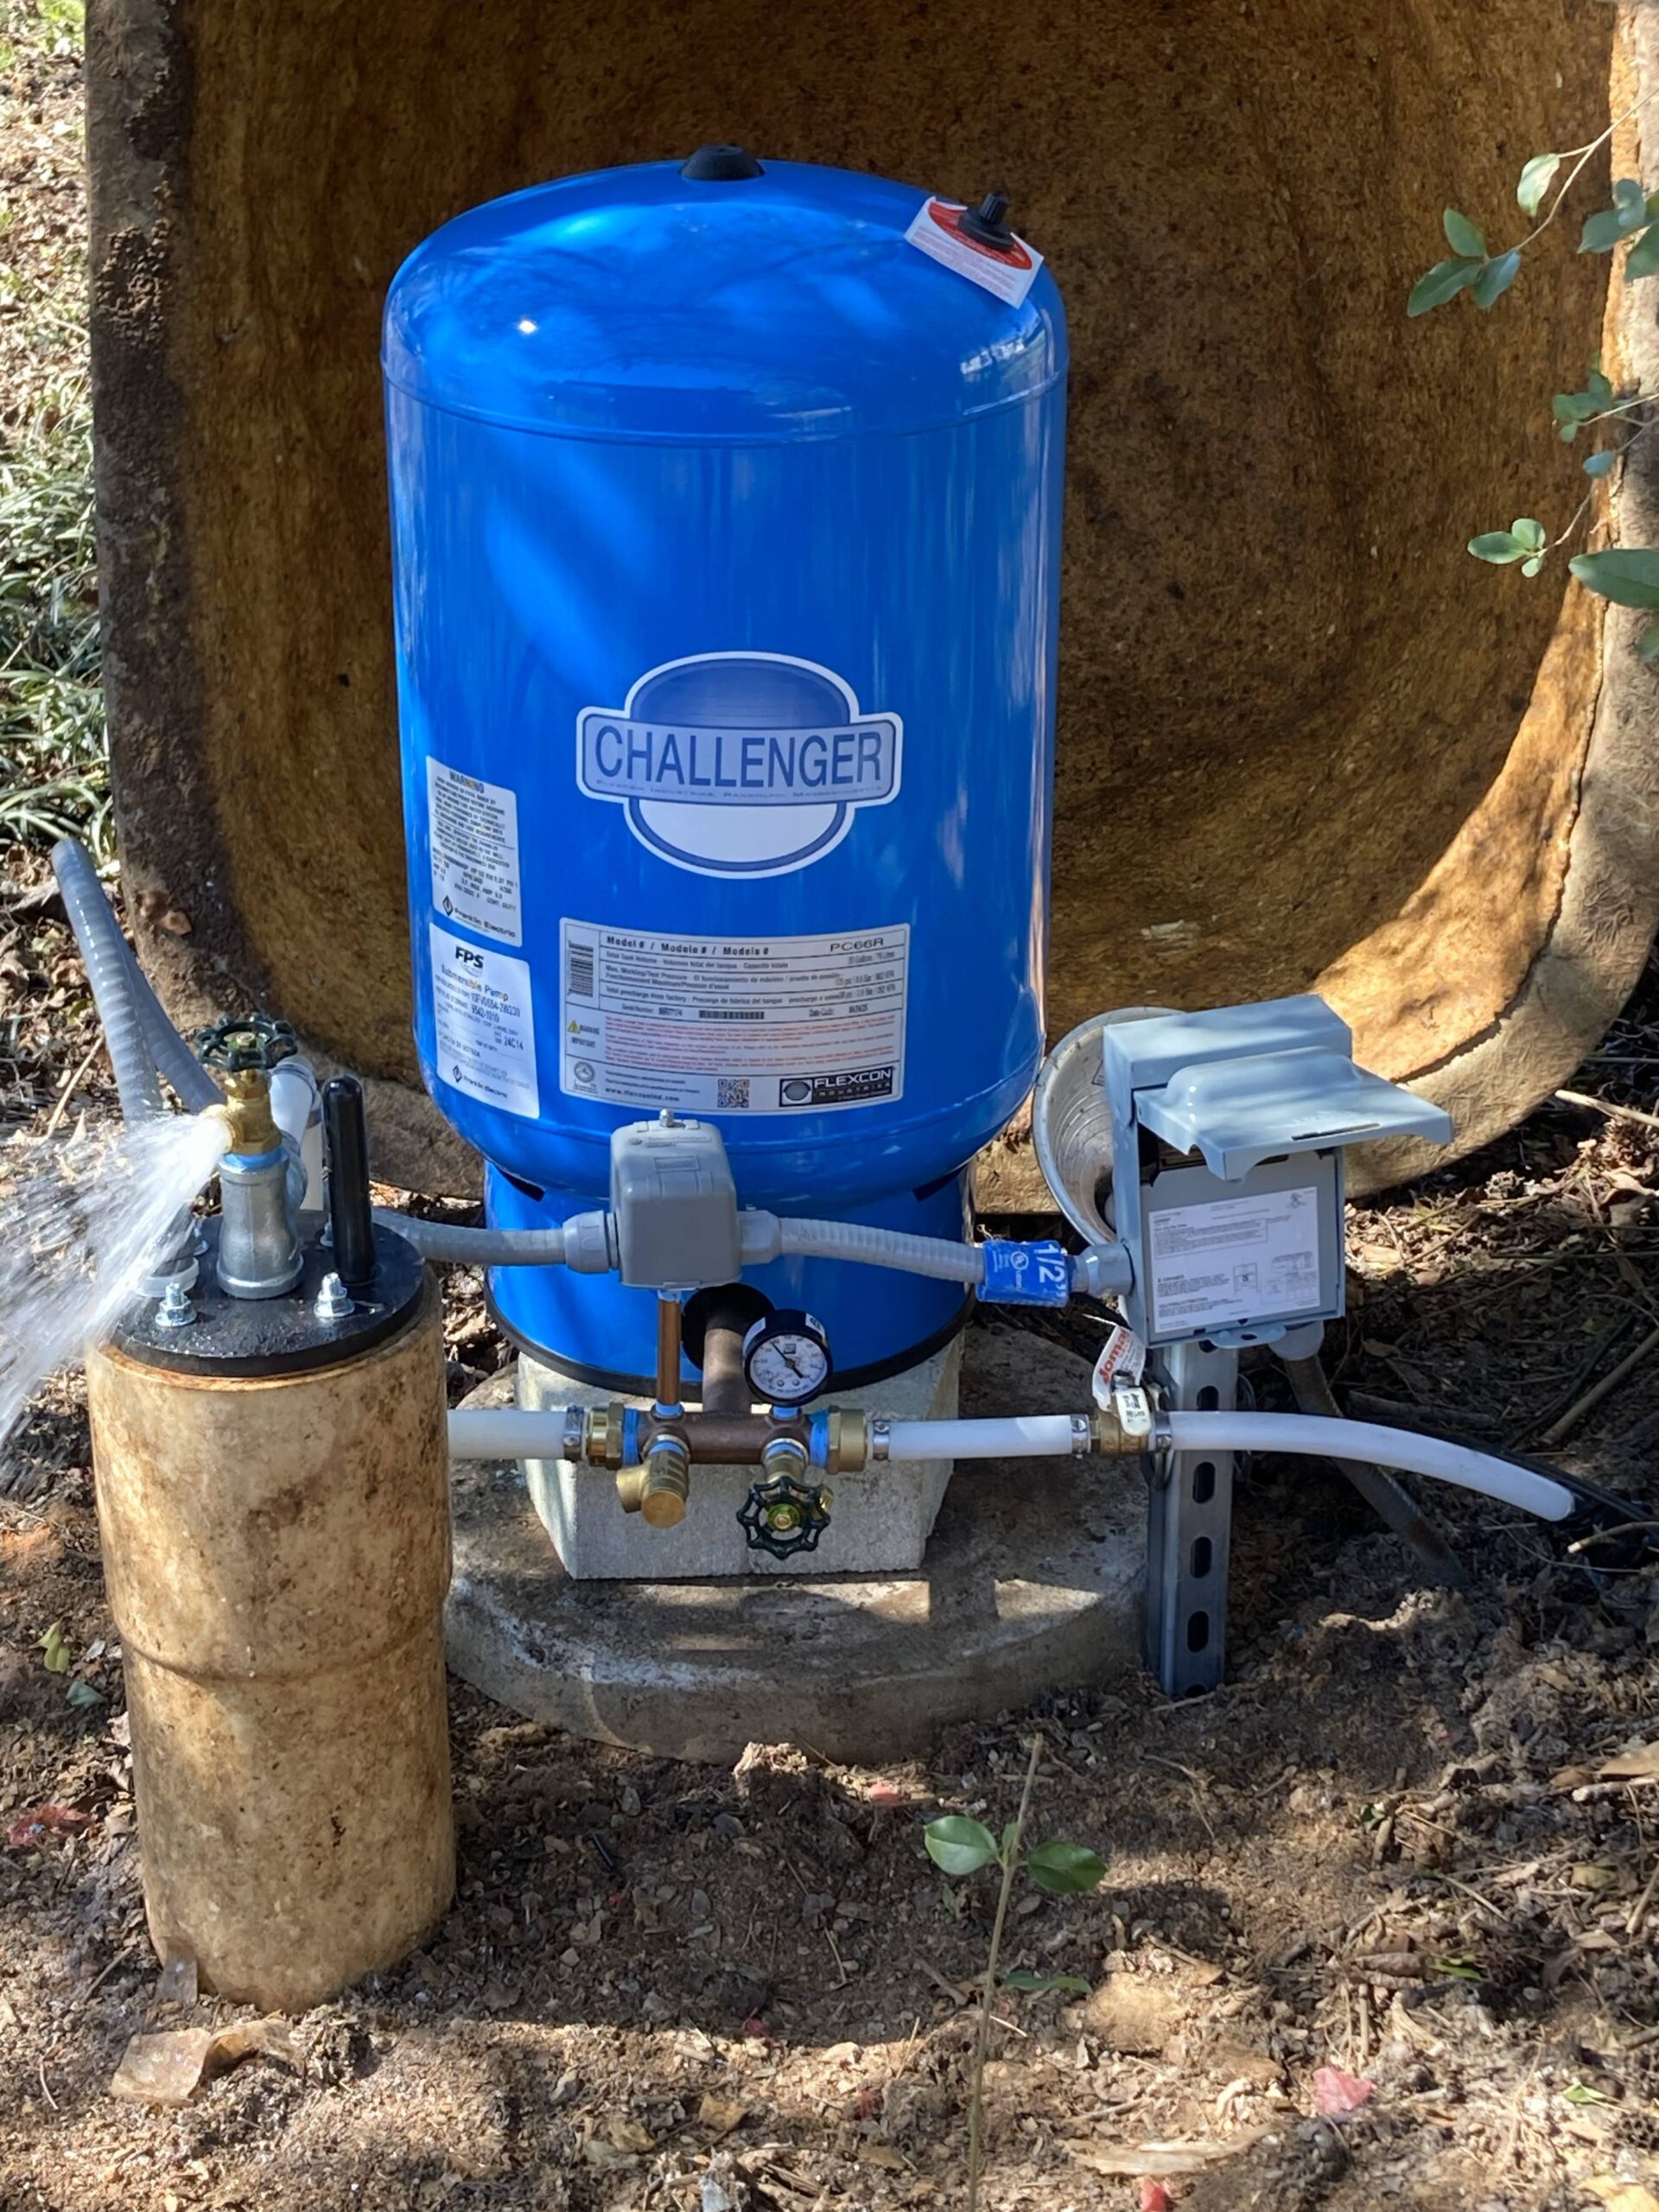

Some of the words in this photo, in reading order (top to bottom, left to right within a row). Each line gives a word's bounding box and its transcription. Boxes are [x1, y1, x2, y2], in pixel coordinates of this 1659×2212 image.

[594, 725, 882, 788] CHALLENGER
[607, 936, 636, 948] Model
[454, 945, 484, 969] FPS
[814, 1069, 891, 1089] FLEXCON
